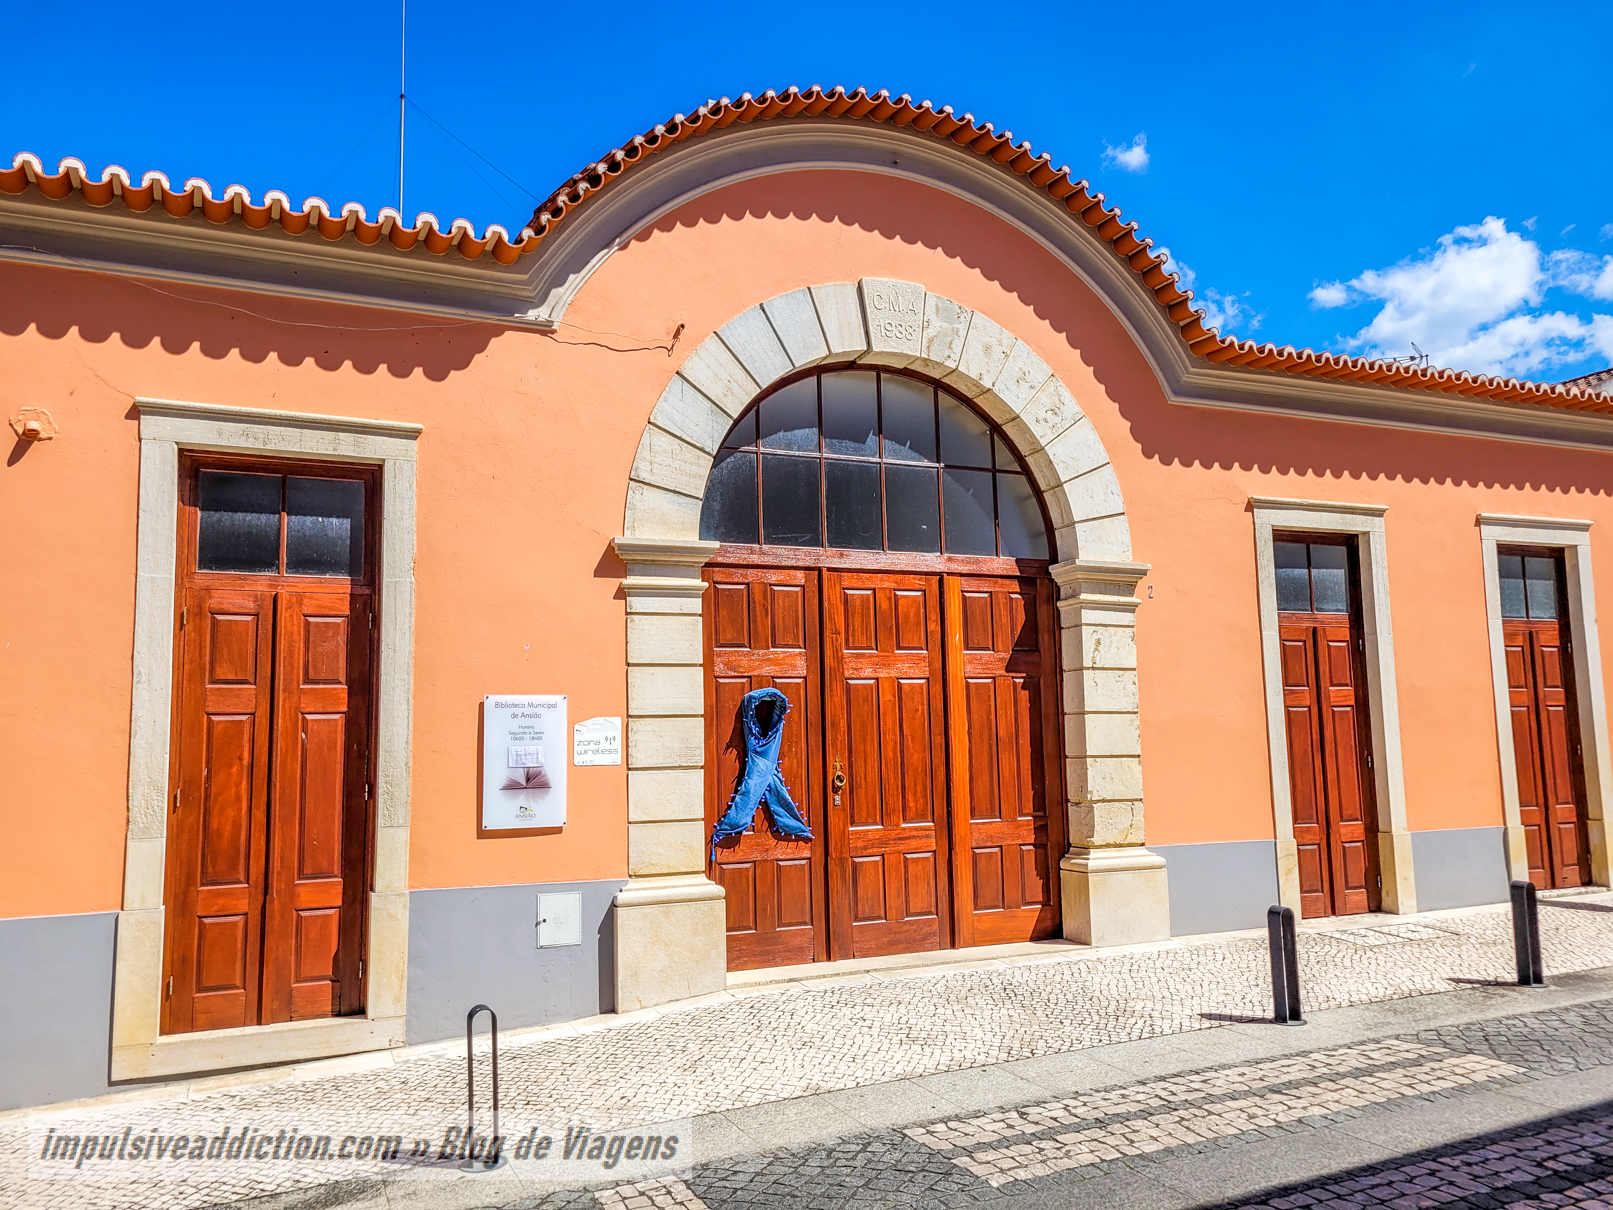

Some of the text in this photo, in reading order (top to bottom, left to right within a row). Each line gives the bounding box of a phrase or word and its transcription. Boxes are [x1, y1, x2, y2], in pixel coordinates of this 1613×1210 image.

[879, 320, 914, 341] 1938
[1147, 584, 1154, 599] 2
[494, 701, 558, 710] Biblioteca Municipal
[510, 711, 542, 719] de Ansião
[576, 747, 619, 756] wireless
